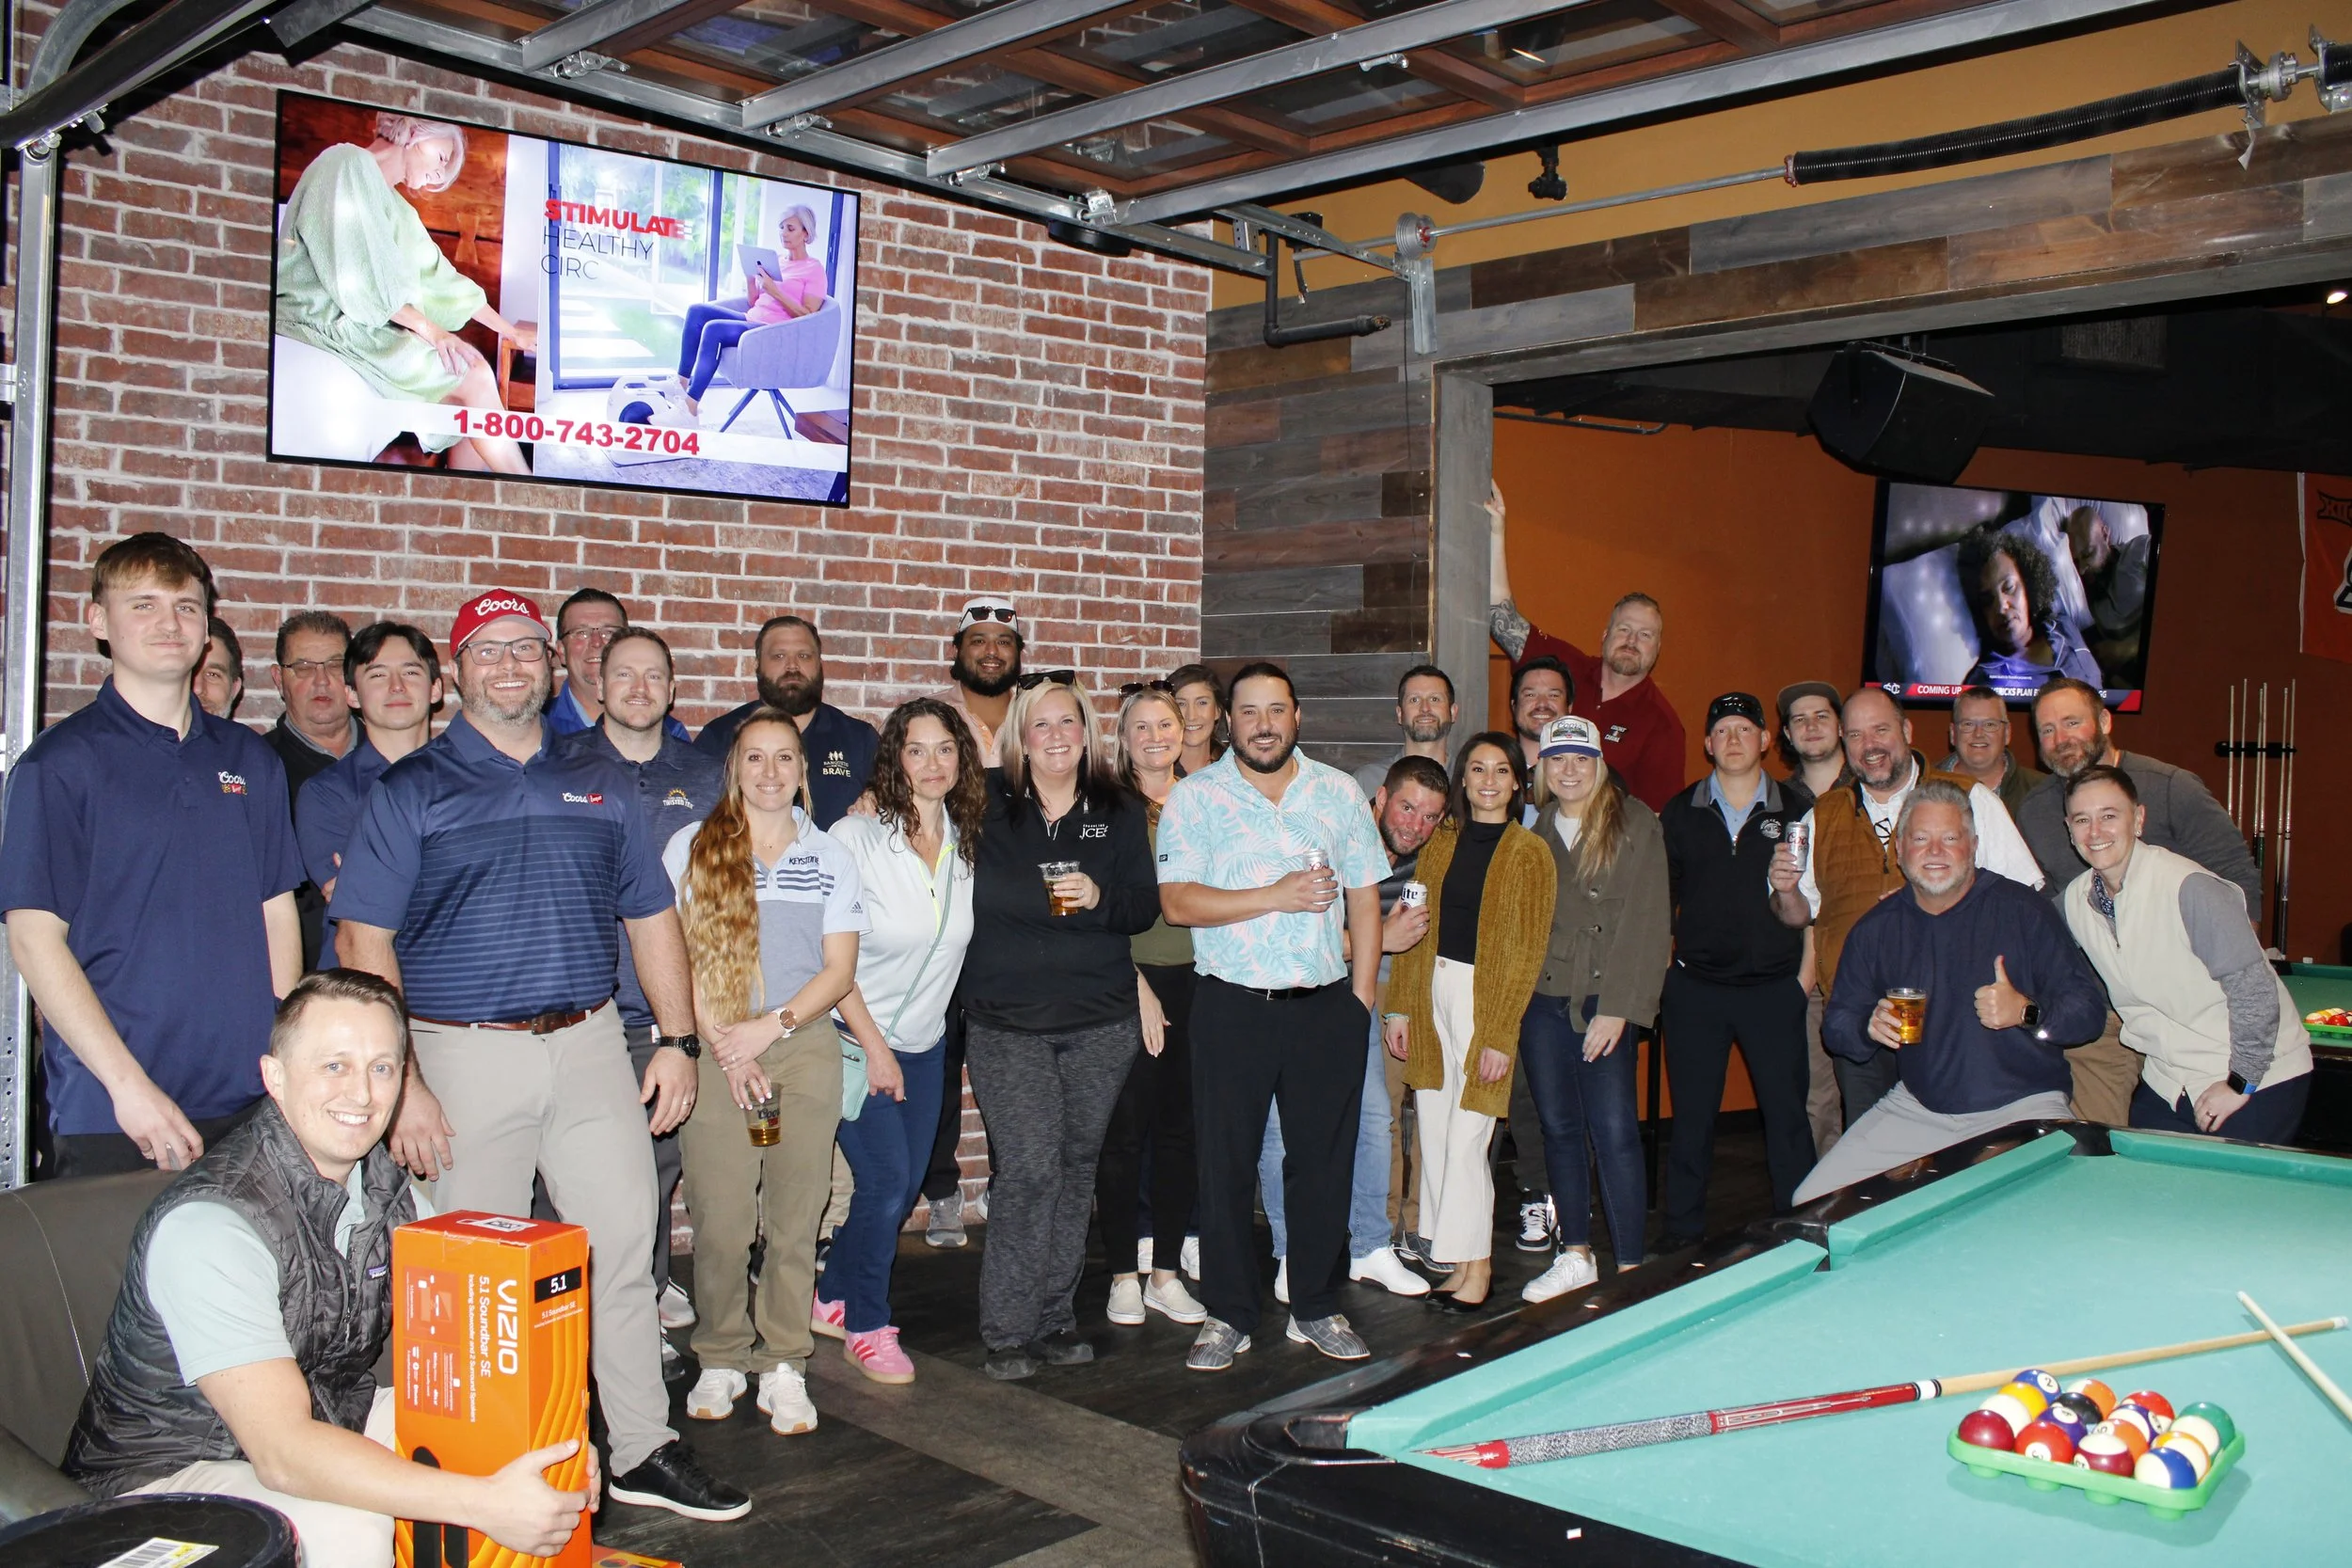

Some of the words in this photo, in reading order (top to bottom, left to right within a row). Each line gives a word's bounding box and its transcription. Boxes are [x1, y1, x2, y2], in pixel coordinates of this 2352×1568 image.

[543, 225, 654, 260] HEALTHY
[541, 254, 598, 279] CIRC
[453, 409, 700, 455] 1-800-743-2704
[474, 598, 530, 616] Coors
[1917, 686, 1949, 695] COMING
[1951, 687, 1963, 695] UP
[2017, 688, 2033, 696] PLAN
[822, 768, 851, 778] BRAVE
[788, 855, 819, 865] KEYSTONE
[467, 1273, 475, 1305] Including
[479, 1275, 490, 1294] 5.1
[550, 1274, 567, 1294] 5.1
[479, 1295, 491, 1357] Soundbar
[497, 1279, 518, 1375] VIZIO
[480, 1360, 491, 1378] SE
[2044, 1376, 2054, 1387] 2
